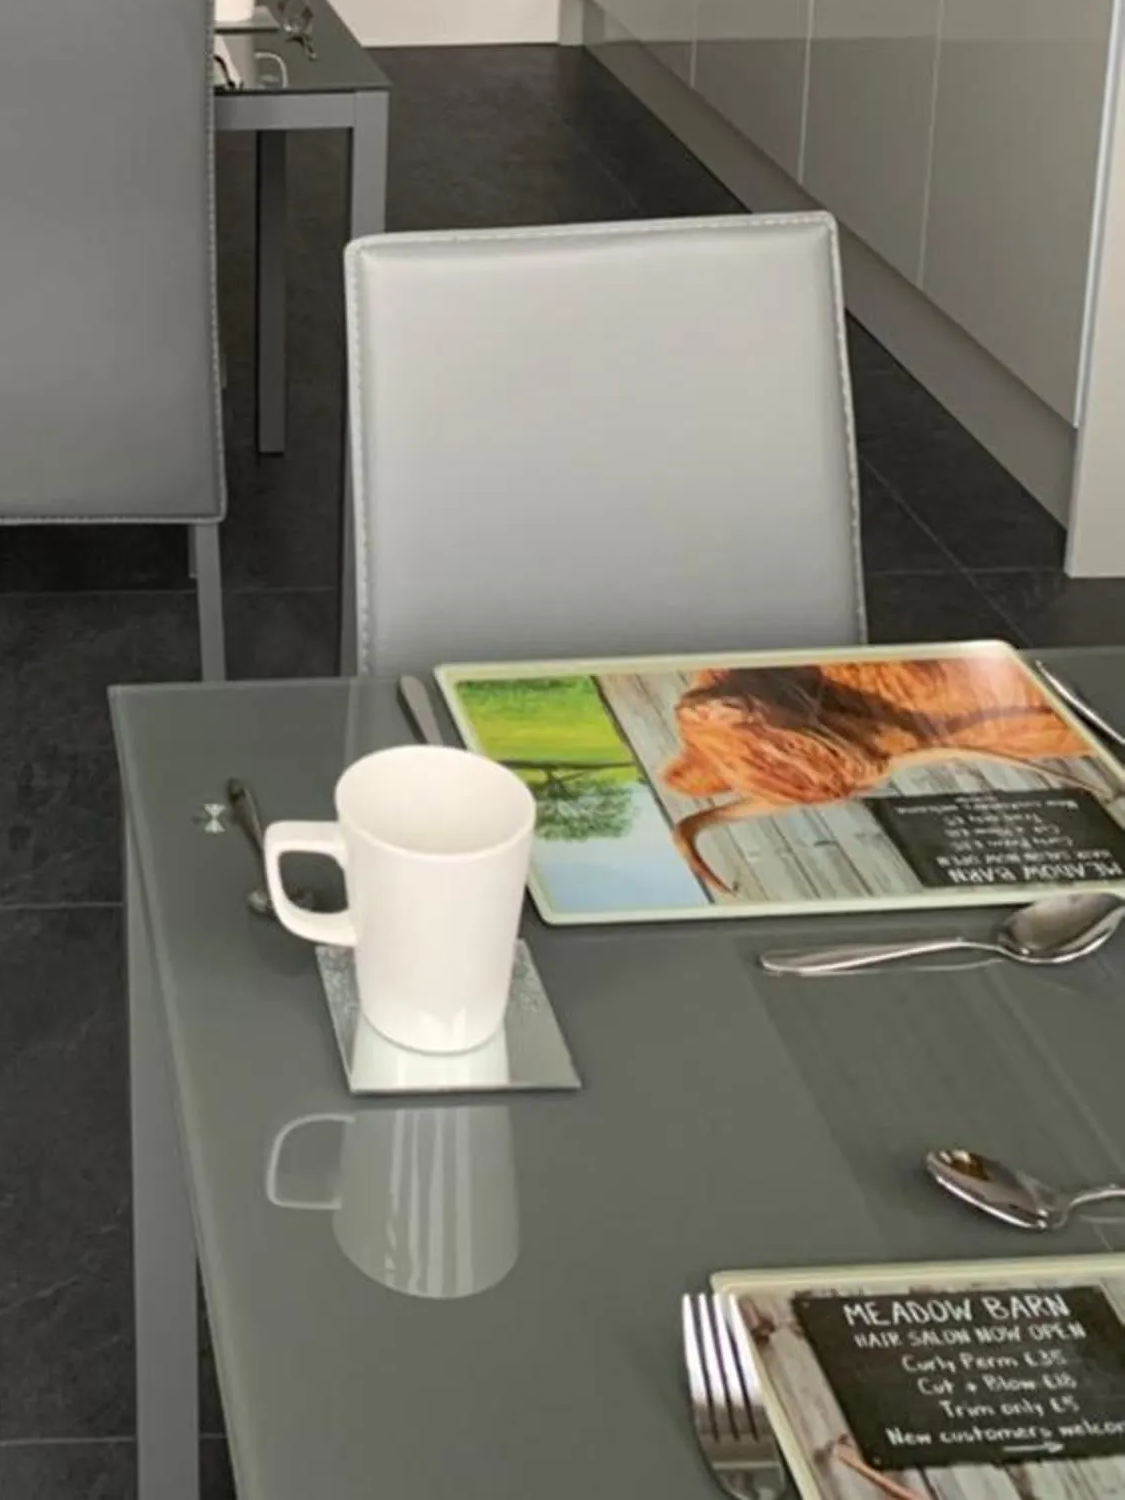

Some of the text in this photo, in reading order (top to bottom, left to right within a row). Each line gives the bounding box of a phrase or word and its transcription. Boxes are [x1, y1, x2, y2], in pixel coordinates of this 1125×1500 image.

[843, 1293, 1071, 1326] MEADOW BARN
[854, 1321, 1087, 1349] HAIR SALON NOW OPEN
[901, 1353, 956, 1374] Curly
[959, 1351, 1019, 1370] Perm
[917, 1376, 954, 1395] Cut
[982, 1373, 1036, 1391] Blow
[939, 1399, 995, 1418] Trim
[1000, 1397, 1044, 1417] only
[885, 1426, 932, 1446] New
[939, 1424, 1053, 1443] customers
